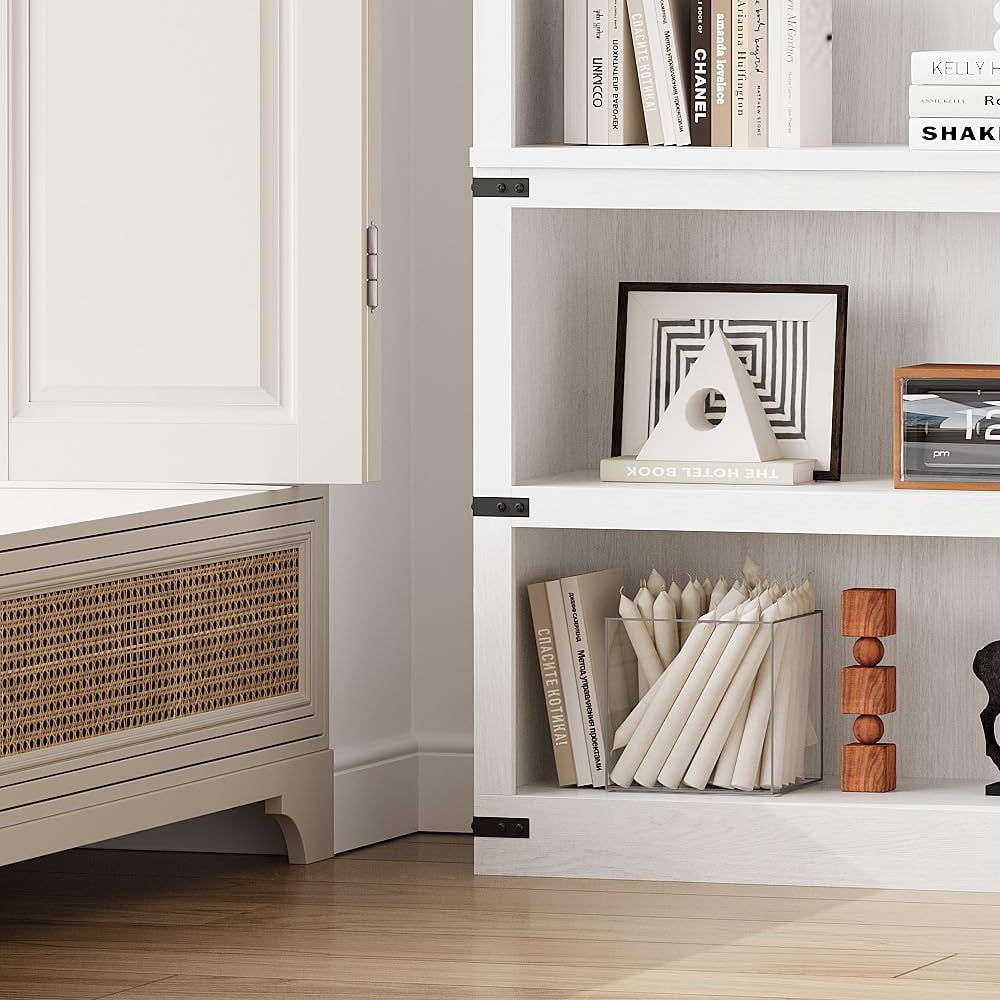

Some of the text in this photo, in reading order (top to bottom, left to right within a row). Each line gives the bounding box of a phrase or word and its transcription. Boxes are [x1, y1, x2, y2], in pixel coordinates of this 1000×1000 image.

[631, 12, 650, 63] СПАСИТЕ
[697, 24, 703, 34] OF
[716, 13, 727, 105] amanda lovelace
[735, 0, 747, 116] Arianna Huffington
[932, 61, 985, 76] KELLY
[694, 48, 707, 124] CHANEL
[626, 466, 779, 479] THE HOTEL BOOK
[933, 449, 950, 459] pm
[577, 649, 587, 676] Метод
[537, 628, 569, 746] СПАСИТЕ КОТИКА!
